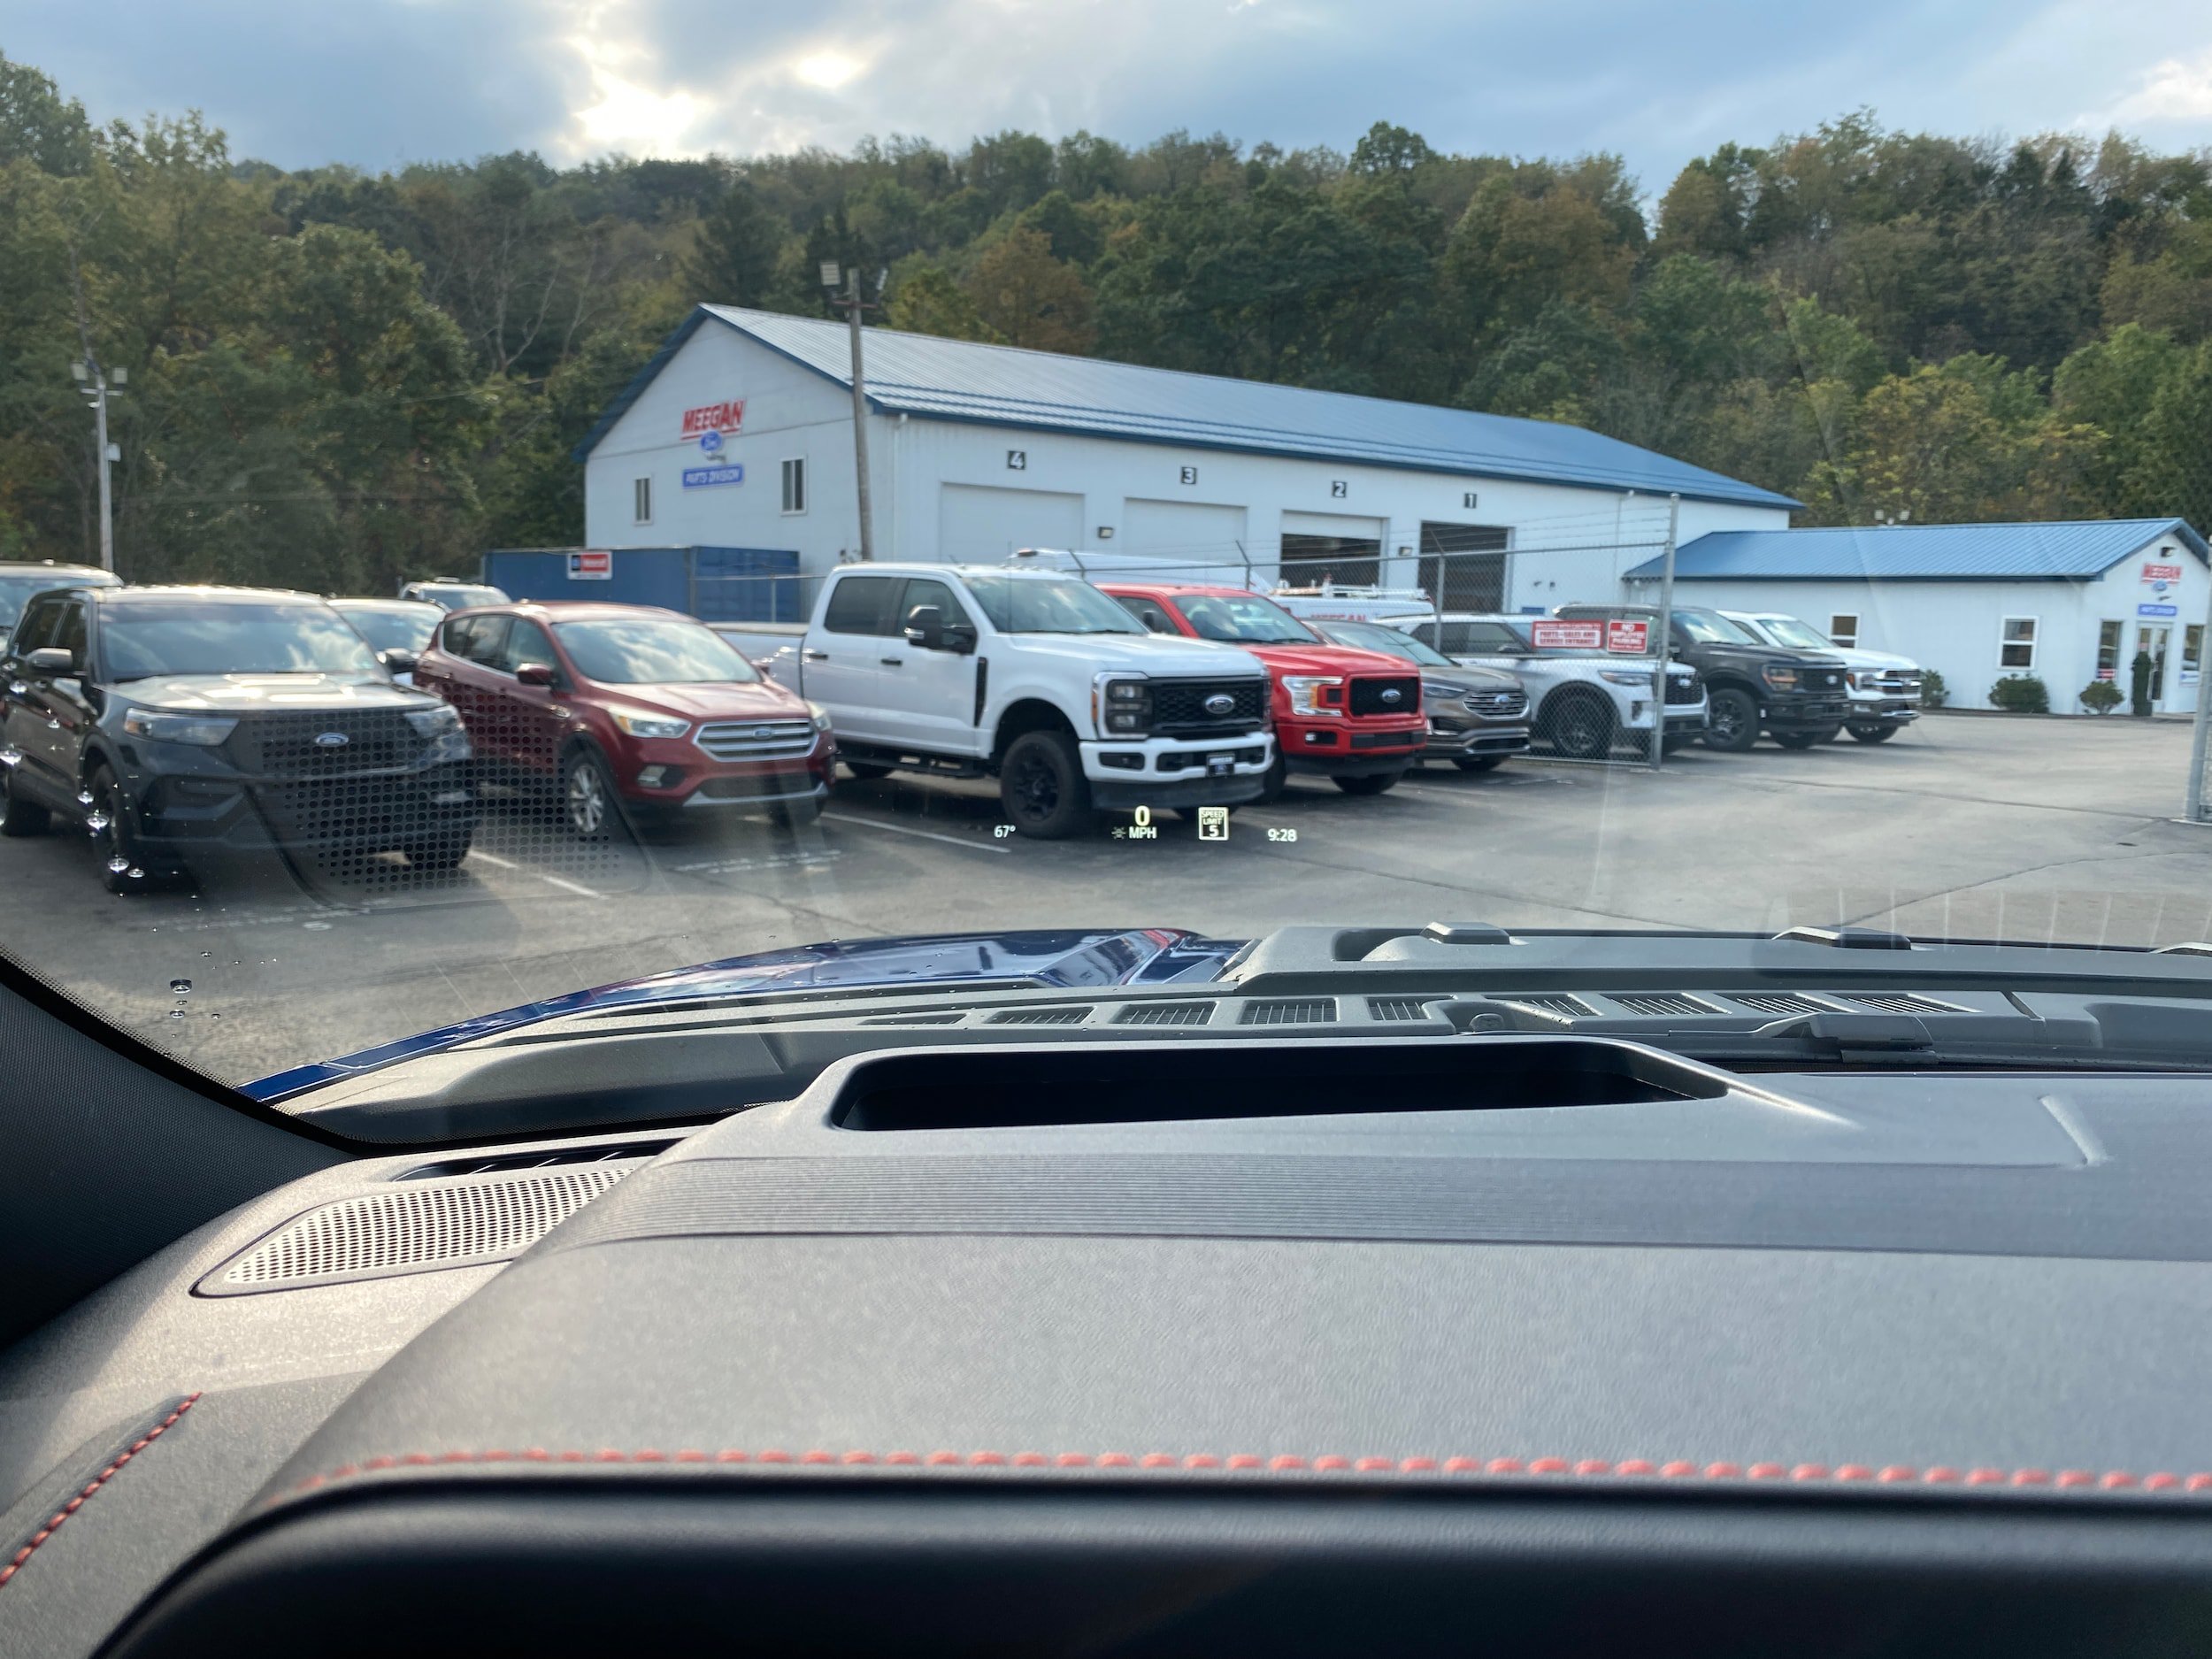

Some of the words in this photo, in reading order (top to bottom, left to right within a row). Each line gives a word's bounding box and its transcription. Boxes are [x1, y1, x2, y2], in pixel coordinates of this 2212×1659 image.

[682, 400, 745, 433] MEEGAN
[1010, 452, 1025, 469] 4
[1184, 468, 1195, 484] 3
[1334, 482, 1345, 497] 2
[1135, 806, 1150, 826] 0
[994, 826, 1016, 838] 67°
[1129, 827, 1156, 839] MPH
[1210, 825, 1219, 837] 5
[1268, 829, 1297, 841] 9:28
